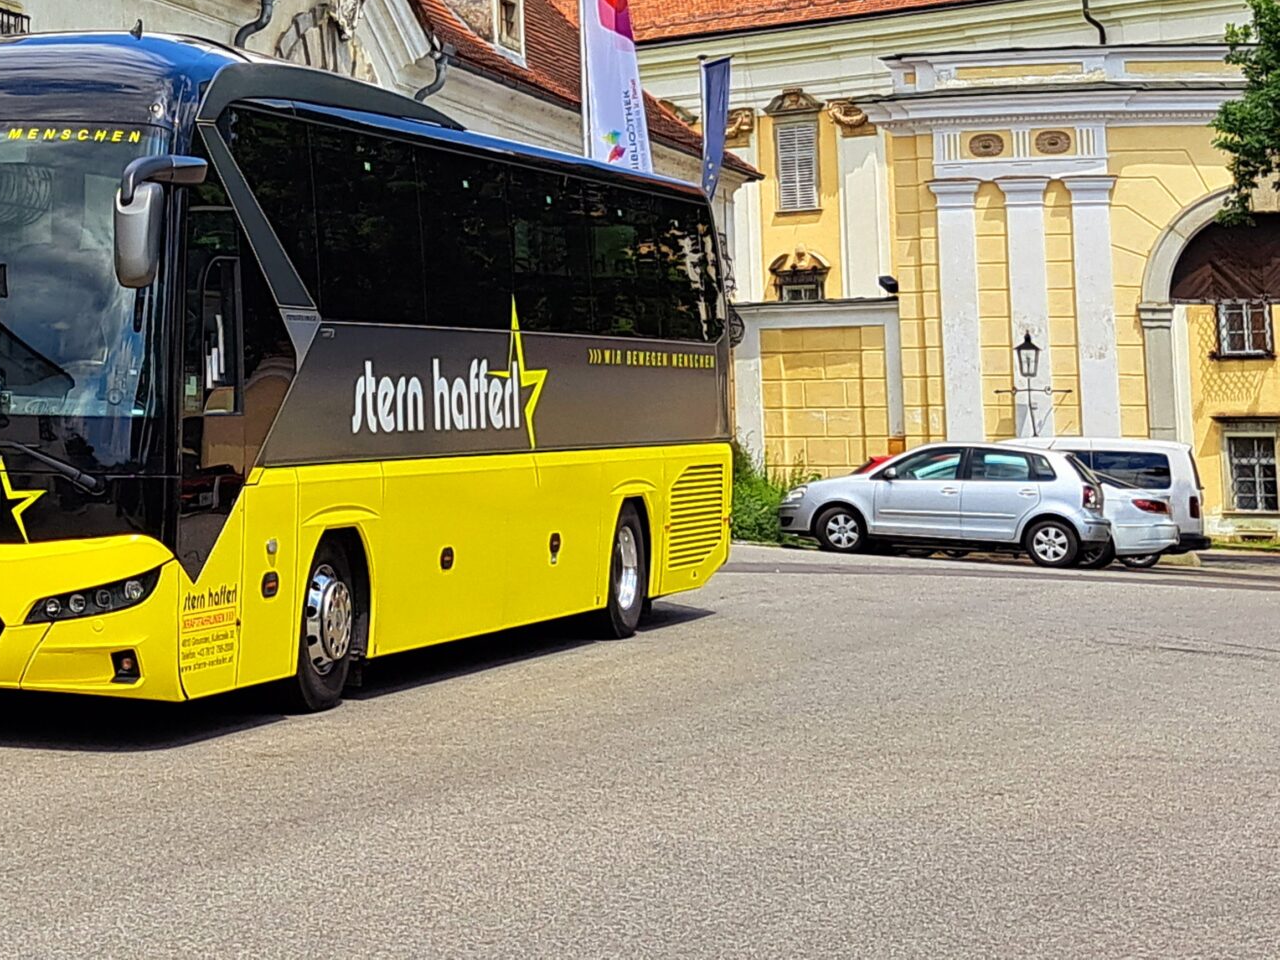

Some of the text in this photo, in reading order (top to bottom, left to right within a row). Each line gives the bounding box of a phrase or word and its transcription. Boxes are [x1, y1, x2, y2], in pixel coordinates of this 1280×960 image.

[8, 127, 142, 144] MENSCHEN
[604, 350, 715, 368] WIR BEWEGEN MENSCHEN
[350, 357, 520, 435] stern hafferl
[183, 583, 237, 611] stern hafferl
